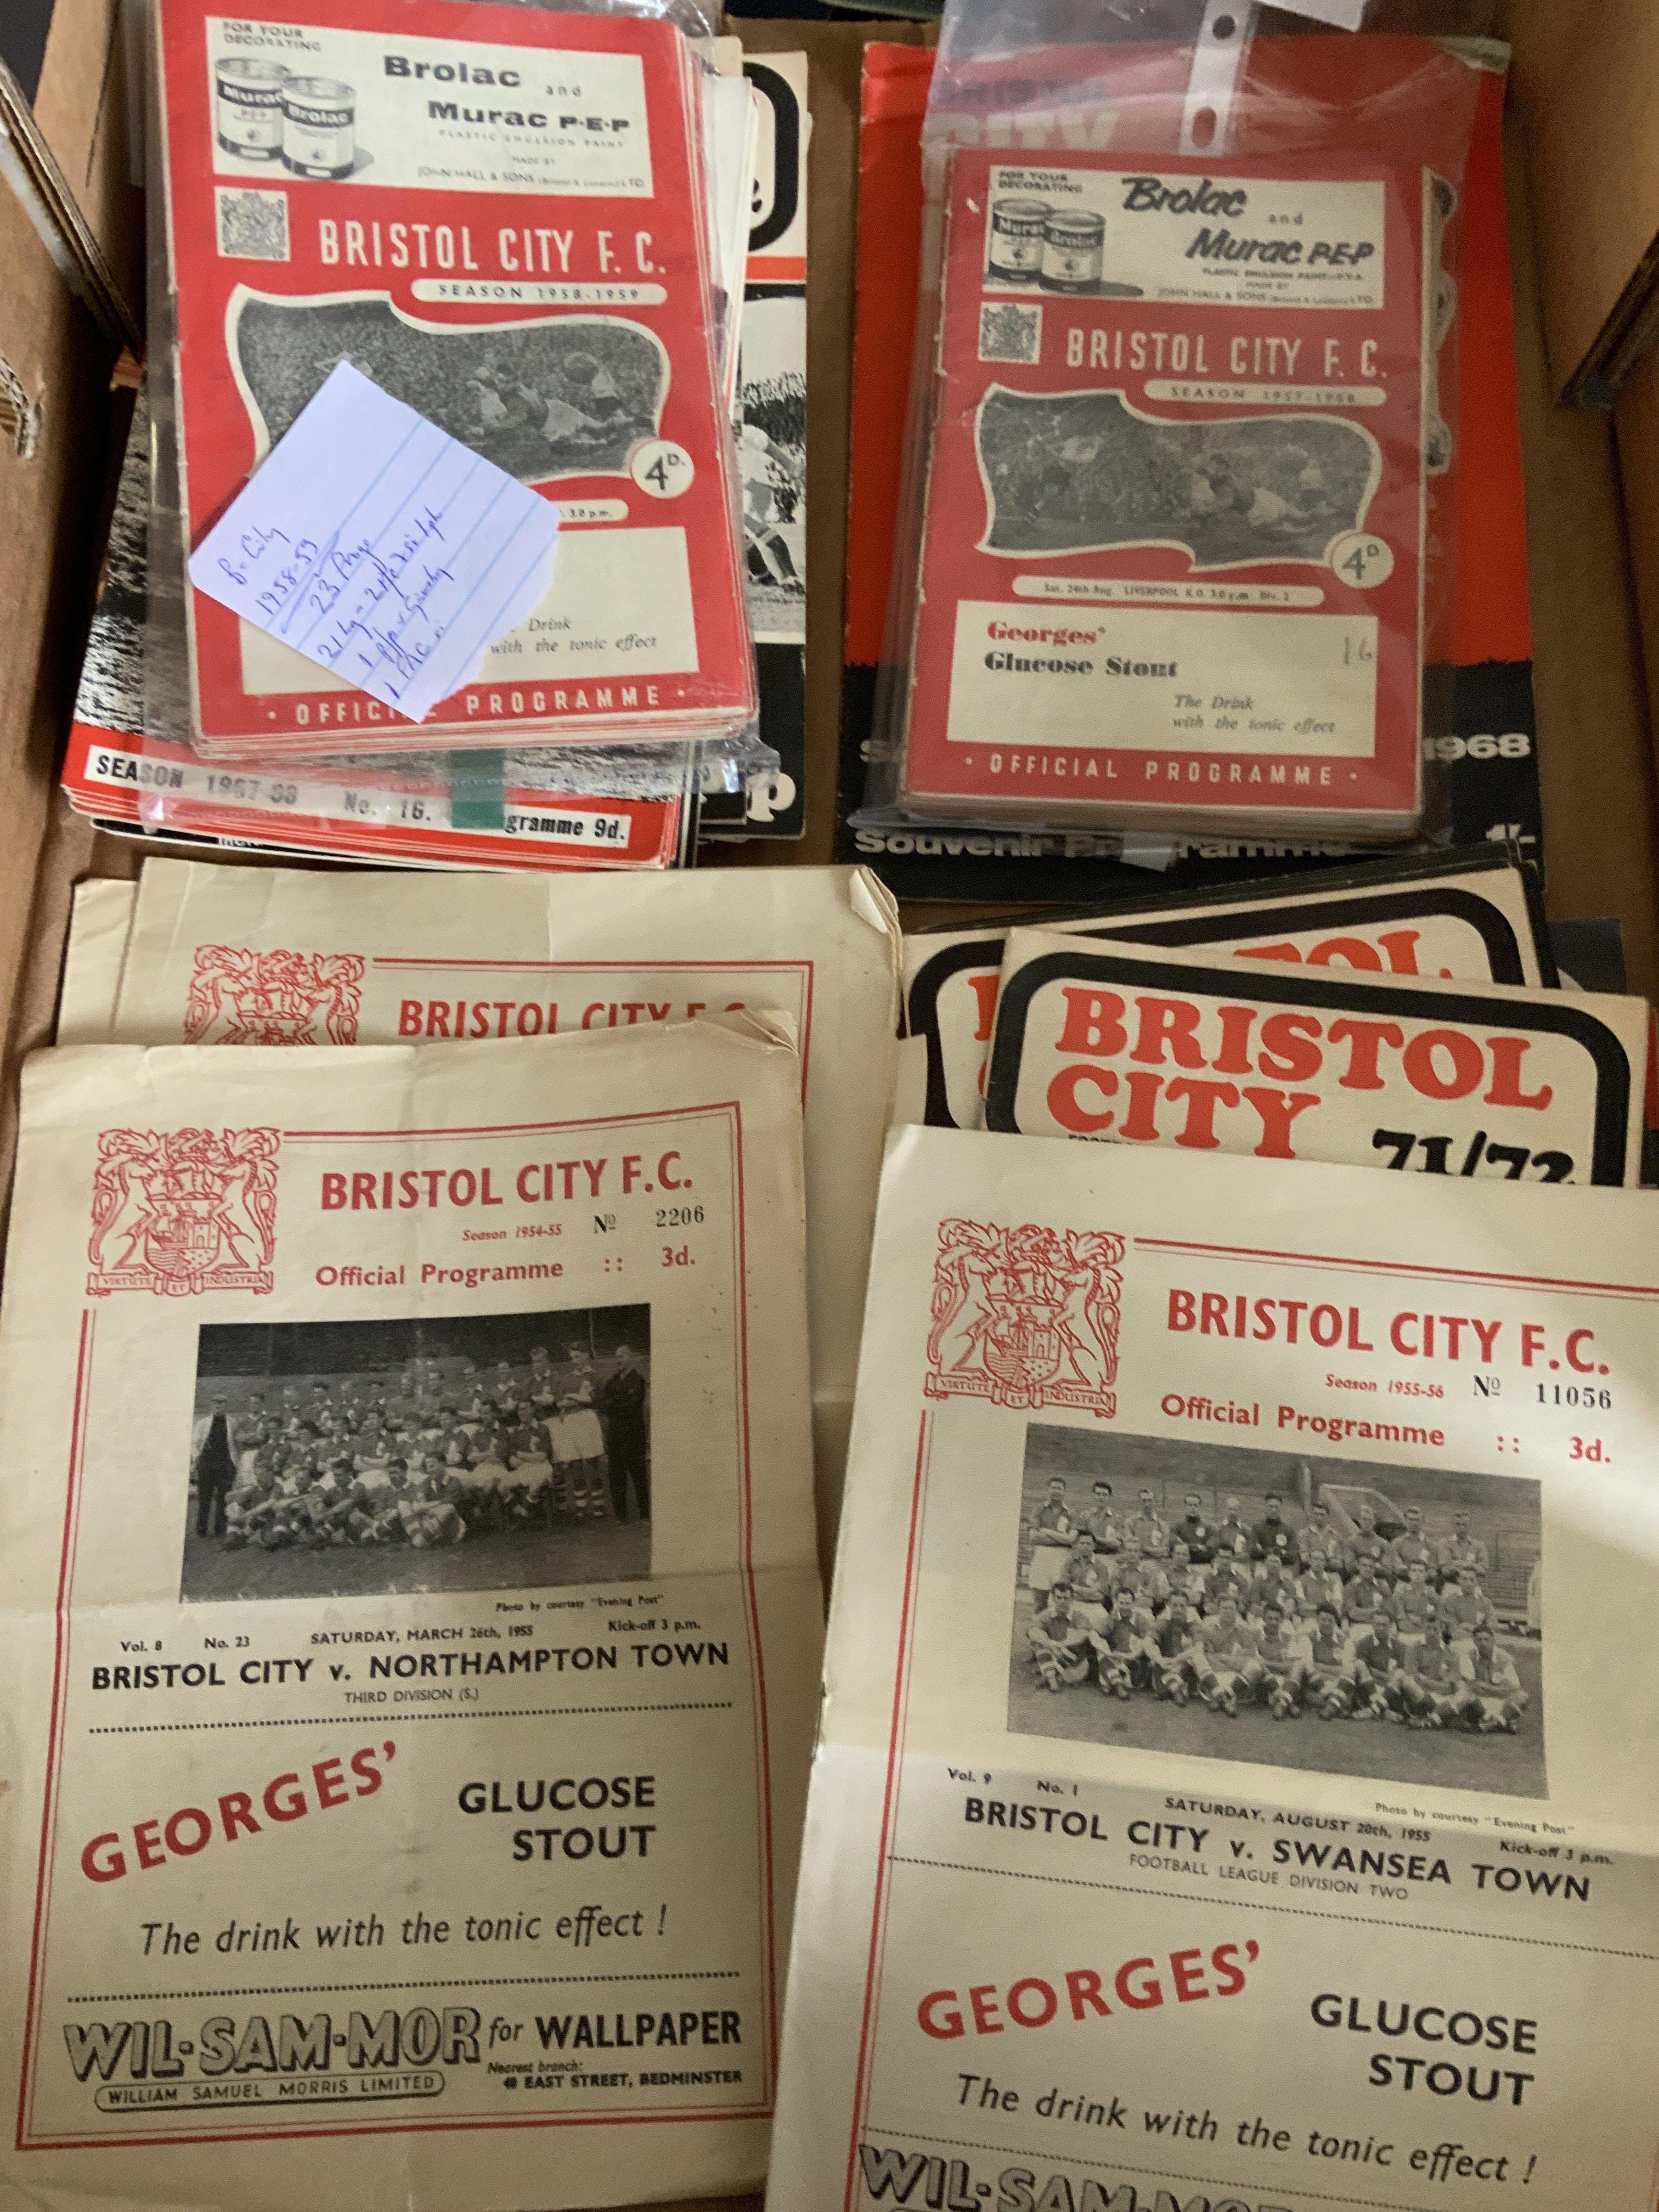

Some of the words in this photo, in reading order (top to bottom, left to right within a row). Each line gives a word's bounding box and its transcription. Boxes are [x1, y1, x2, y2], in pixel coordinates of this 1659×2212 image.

[223, 21, 252, 33] FOR
[259, 25, 303, 38] YOUR
[223, 33, 322, 51] DECORATING
[384, 55, 521, 88] Brolac
[546, 84, 582, 98] and
[427, 99, 548, 128] Murac
[998, 180, 1082, 193] DECORATING
[1030, 172, 1068, 182] YOUR
[1122, 177, 1248, 217] Brolac
[1268, 213, 1303, 225] and
[319, 219, 479, 272] BRISTOL
[498, 227, 574, 273] CITY
[1184, 227, 1304, 266] Murac
[438, 283, 523, 300] SEASON
[1066, 328, 1209, 374] BRISTOL
[1231, 336, 1302, 376] CITY
[1170, 386, 1245, 400] SEASON
[491, 637, 522, 653] with
[535, 637, 559, 653] the
[570, 636, 607, 652] tonic
[615, 633, 658, 652] effect
[528, 617, 572, 632] Drink
[986, 620, 1107, 647] Georges'
[985, 651, 1093, 675] Glucose
[1105, 656, 1178, 678] Stout
[466, 685, 659, 713] PROGRAMME
[1173, 694, 1202, 709] The
[1211, 694, 1255, 710] Drink
[1172, 715, 1204, 731] with
[1216, 716, 1238, 732] the
[1248, 718, 1284, 732] tonic
[1293, 718, 1335, 735] effect
[990, 753, 1118, 778] OFFICIAL
[1146, 760, 1332, 785] PROGRAMME
[96, 755, 184, 788] SEASON
[343, 792, 377, 816] No.
[505, 814, 583, 834] gramme
[594, 818, 625, 840] 9d.
[398, 999, 558, 1039] BRISTOL
[1055, 986, 1553, 1112] BRISTOL
[1046, 1063, 1322, 1160] CITY
[320, 1167, 503, 1210] BRISTOL
[516, 1157, 607, 1203] CITY
[621, 1150, 694, 1194] F.C.
[462, 1228, 507, 1242] Season
[655, 1205, 705, 1228] 2206
[315, 1264, 405, 1288] Official
[420, 1262, 564, 1289] Programme
[661, 1246, 696, 1268] 3d.
[1167, 1287, 1374, 1352] BRISTOL
[1390, 1311, 1503, 1363] CITY
[1520, 1324, 1611, 1375] F.C.
[1325, 1373, 1378, 1394] Season
[1387, 1380, 1446, 1400] 1955-56
[1536, 1383, 1613, 1411] 11056
[1160, 1393, 1260, 1427] Official
[1277, 1404, 1446, 1447] Programme
[1568, 1437, 1612, 1464] 3d.
[495, 1601, 524, 1613] Photo
[529, 1600, 540, 1612] by
[120, 1640, 148, 1652] Vol.
[154, 1640, 162, 1651] 8
[204, 1637, 228, 1649] No.
[235, 1636, 250, 1647] 23
[311, 1629, 401, 1645] SATURDAY,
[407, 1627, 463, 1641] MARCH
[507, 1624, 534, 1638] 1955
[608, 1618, 656, 1633] Kick-off
[661, 1619, 669, 1630] 3
[674, 1620, 702, 1632] p.m.
[92, 1662, 226, 1690] BRISTOL
[239, 1657, 314, 1685] CITY
[329, 1664, 351, 1681] v.
[369, 1645, 618, 1679] NORTHAMPTON
[631, 1641, 730, 1668] TOWN
[344, 1691, 387, 1704] THIRD
[393, 1688, 453, 1703] DIVISION
[80, 1739, 397, 1884] GEORGES'
[456, 1774, 656, 1815] GLUCOSE
[947, 1768, 976, 1783] Vol.
[983, 1772, 992, 1785] 9
[1036, 1779, 1064, 1795] No.
[1273, 1812, 1350, 1831] AUGUST
[1400, 1827, 1431, 1842] 1955
[1499, 1839, 1561, 1859] Kick-off
[1565, 1849, 1574, 1861] 3
[1579, 1850, 1615, 1866] p.m.
[1375, 1802, 1408, 1816] Photo
[1412, 1807, 1426, 1819] by
[1431, 1810, 1479, 1826] courtesy
[511, 1824, 657, 1862] STOUT
[964, 1796, 1109, 1842] BRISTOL
[1127, 1820, 1210, 1853] CITY
[1229, 1839, 1254, 1860] v.
[1273, 1838, 1452, 1885] SWANSEA
[1471, 1863, 1591, 1903] TOWN
[1129, 1853, 1209, 1876] FOOTBALL
[1218, 1865, 1279, 1886] LEAGUE
[1289, 1873, 1359, 1895] DIVISION
[1370, 1883, 1409, 1901] TWO
[139, 1922, 201, 1957] The
[215, 1917, 301, 1953] drink
[315, 1912, 385, 1949] with
[401, 1910, 451, 1945] the
[464, 1909, 542, 1943] tonic
[555, 1905, 645, 1949] effect
[916, 1939, 1261, 2040] GEORGES'
[488, 2016, 523, 2049] for
[534, 2010, 742, 2050] WALLPAPER
[1310, 1991, 1538, 2056] GLUCOSE
[487, 2060, 534, 2075] Nearest
[524, 2075, 565, 2089] EAST
[569, 2073, 634, 2089] STREET,
[639, 2070, 743, 2086] BEDMINSTER
[1368, 2052, 1536, 2108] STOUT
[108, 2087, 178, 2105] WILLIAM
[193, 2084, 263, 2101] SAMUEL
[279, 2079, 349, 2096] MORRIS
[360, 2074, 435, 2092] LIMITED
[957, 2073, 1020, 2115] The
[1035, 2087, 1127, 2130] drink
[1143, 2107, 1218, 2144] with
[1236, 2119, 1291, 2153] the
[1307, 2128, 1393, 2169] tonic
[1408, 2143, 1510, 2186] effect
